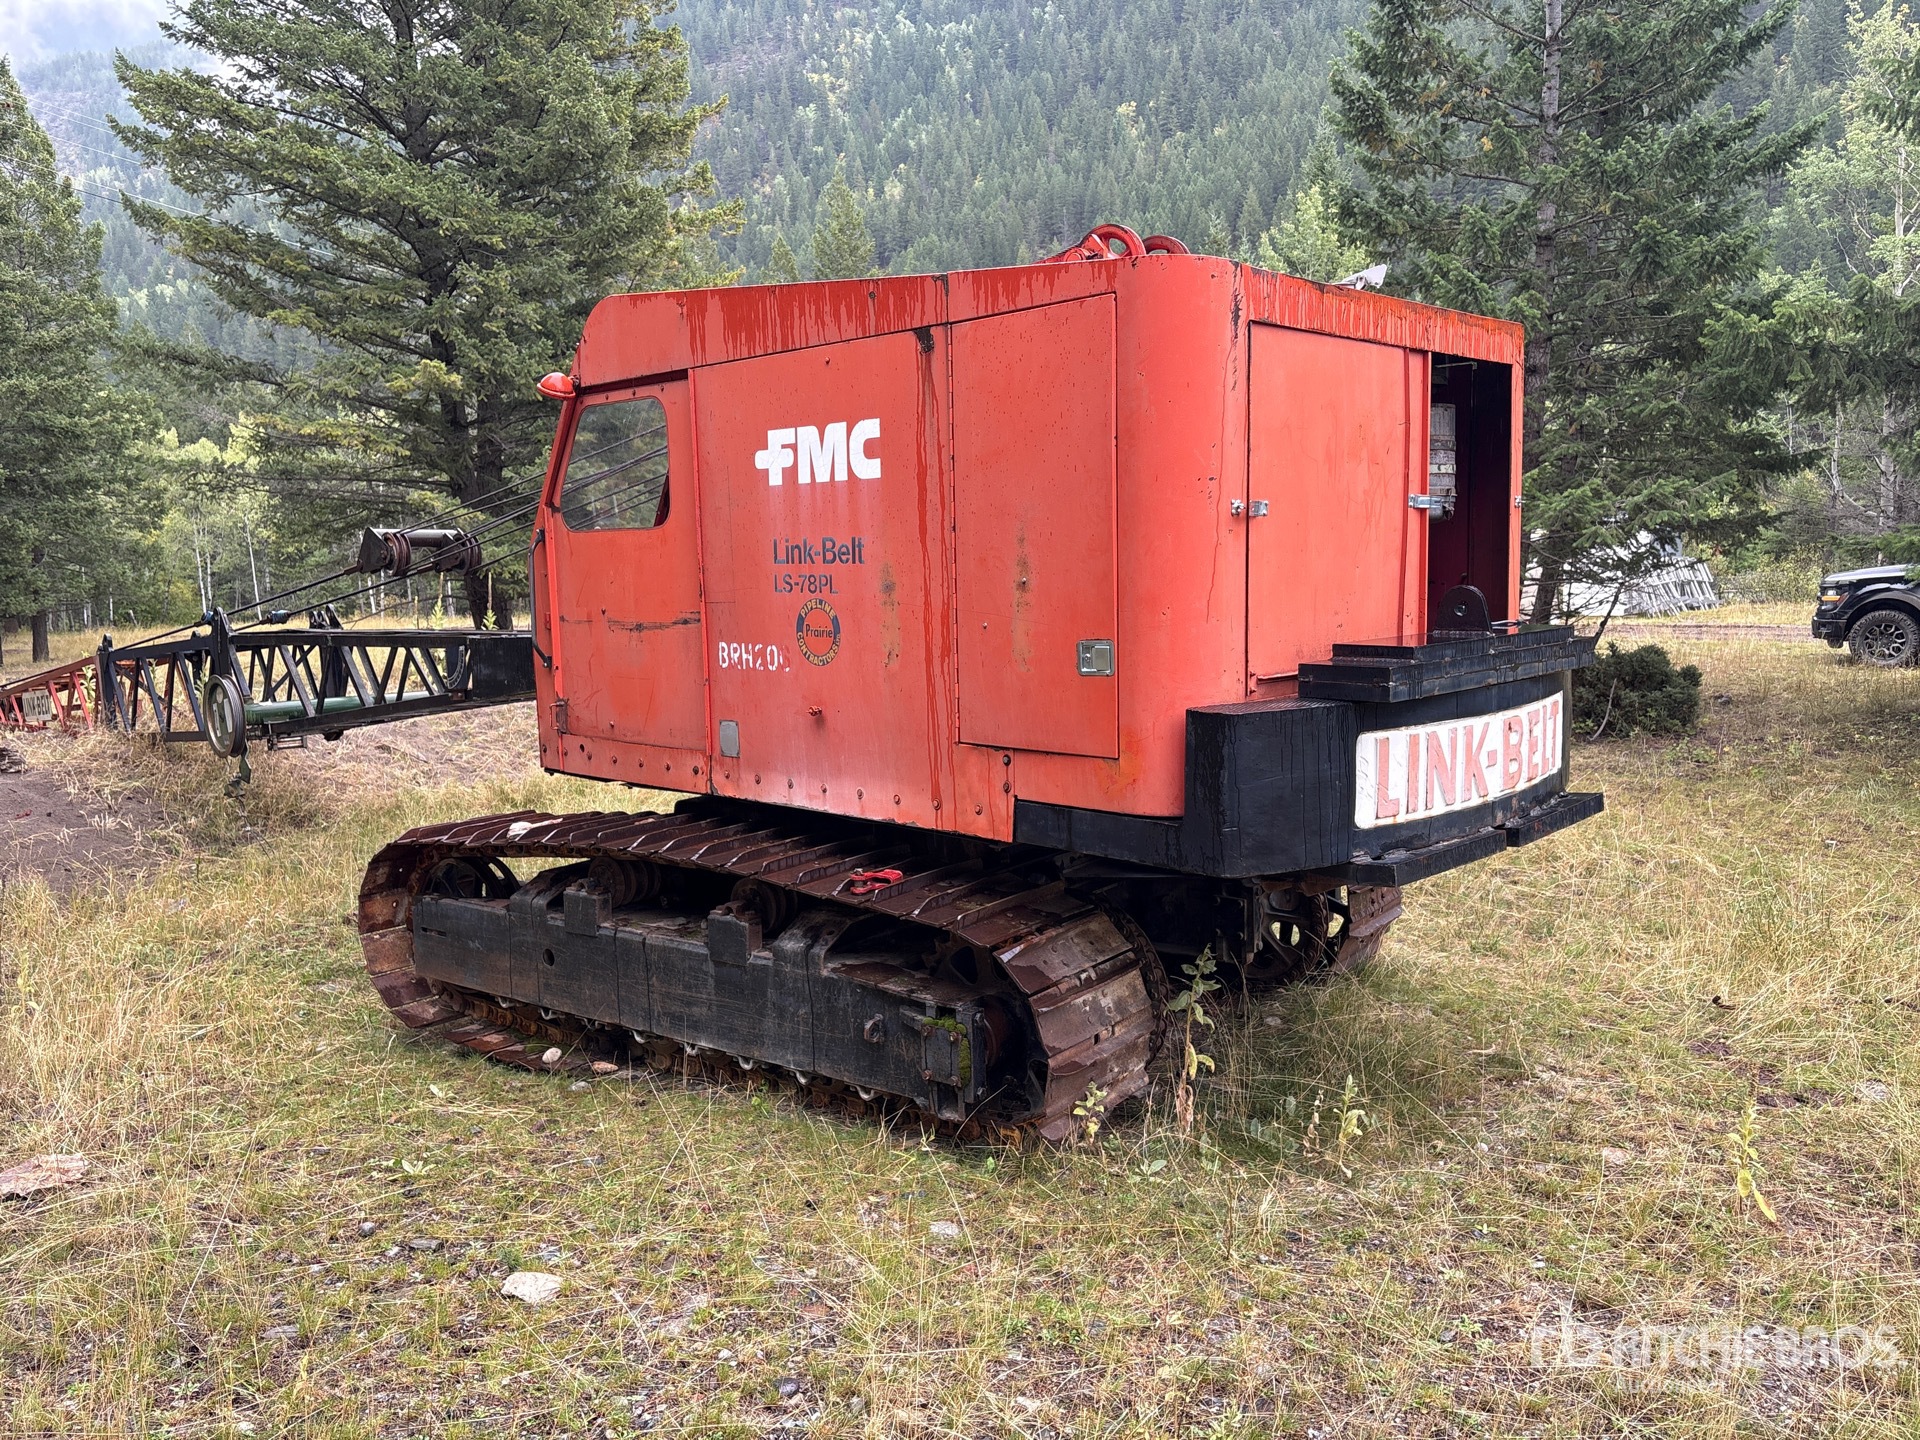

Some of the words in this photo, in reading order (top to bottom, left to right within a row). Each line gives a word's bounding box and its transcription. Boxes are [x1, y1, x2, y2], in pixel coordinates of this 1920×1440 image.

[755, 418, 881, 486] FMC
[773, 536, 865, 565] Link-Belt
[774, 573, 838, 595] LS-78PL
[800, 599, 836, 619] PIPELINE
[805, 624, 833, 638] Prairie
[797, 632, 838, 666] CONTRACTORS
[1376, 700, 1560, 819] LINK-BELT
